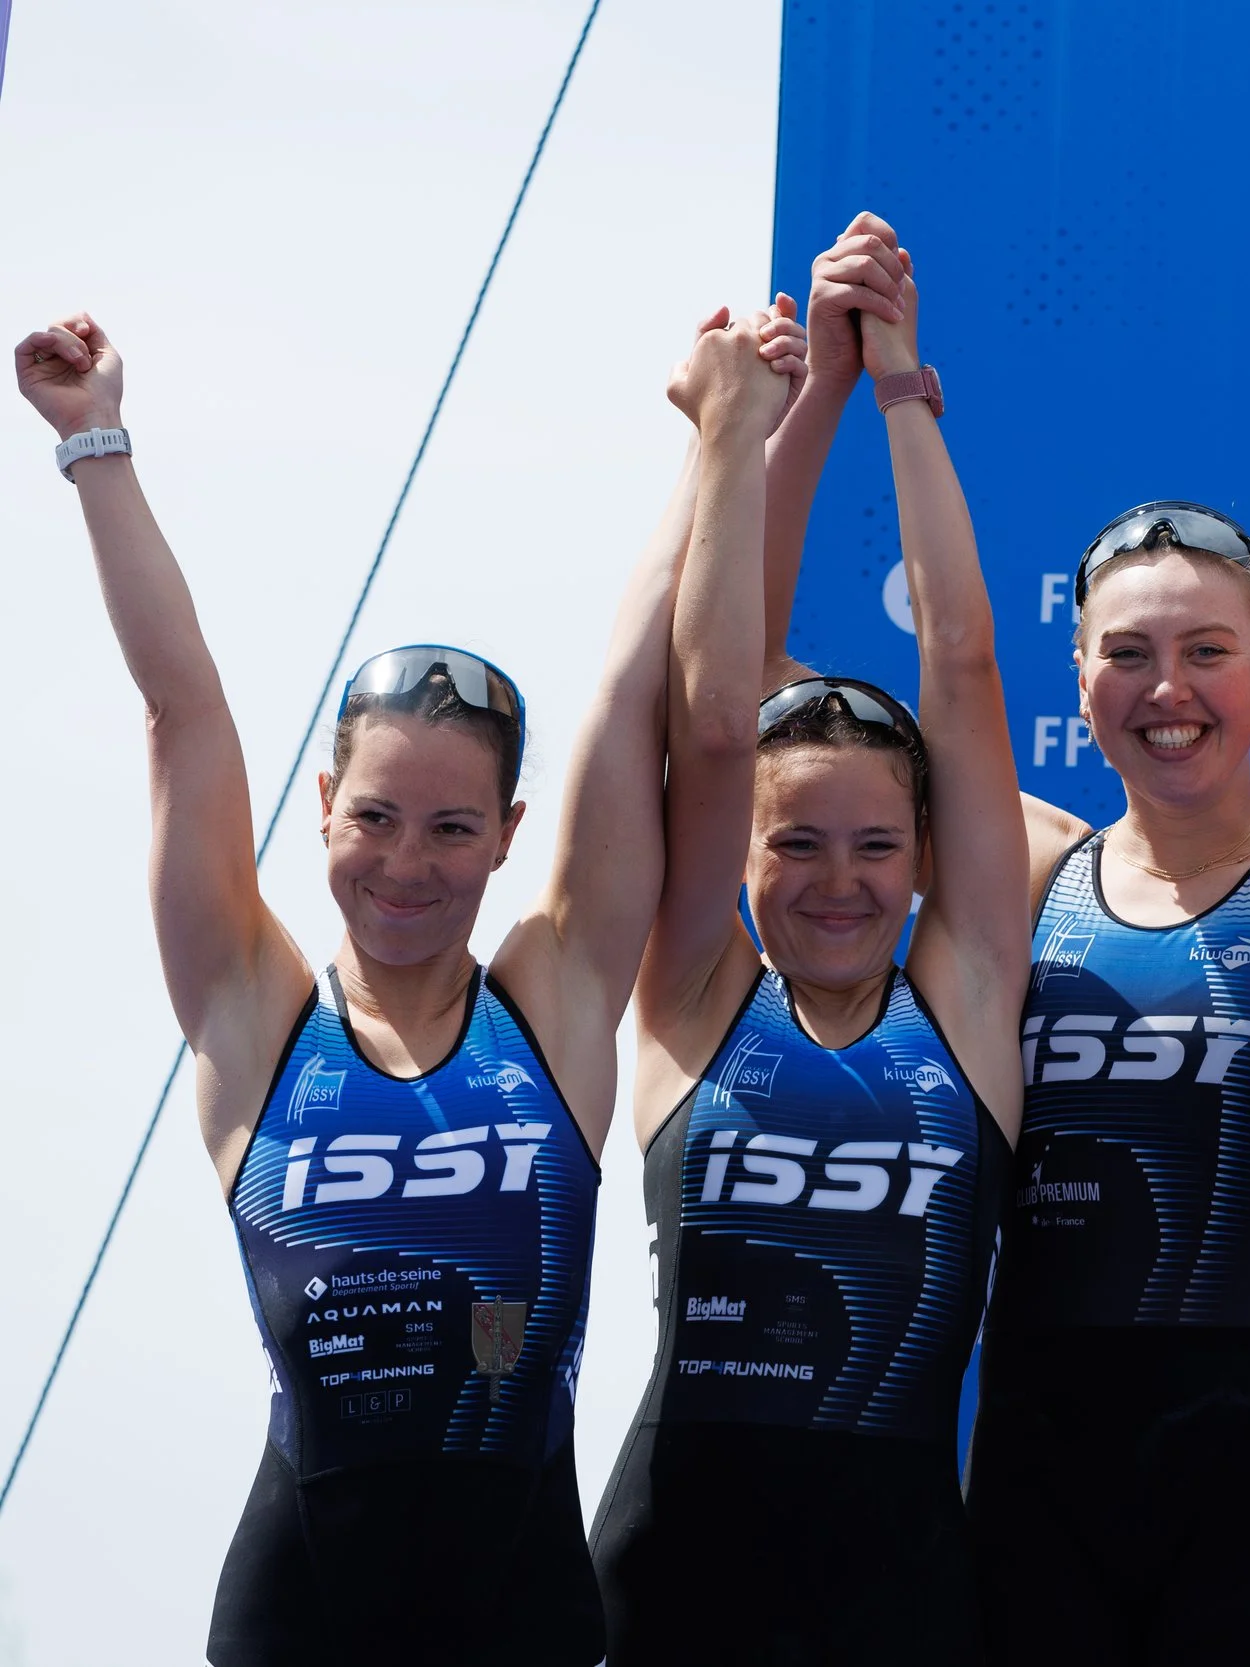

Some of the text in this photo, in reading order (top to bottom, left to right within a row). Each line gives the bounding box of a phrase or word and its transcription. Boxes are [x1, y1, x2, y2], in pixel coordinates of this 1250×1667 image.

[1053, 953, 1082, 968] ISSY
[468, 1071, 525, 1090] kiwami
[738, 1069, 770, 1086] ISSY
[884, 1066, 946, 1085] kiwami
[309, 1088, 337, 1103] ISSY
[281, 1122, 552, 1212] ISSY
[700, 1130, 965, 1218] ISSY
[1040, 1181, 1100, 1203] PREMIUM
[1056, 1216, 1086, 1226] France
[332, 1281, 420, 1297] Département Sportif
[306, 1300, 443, 1325] AQUAMAN
[686, 1296, 747, 1321] BigMat
[405, 1322, 433, 1333] SMS
[308, 1334, 365, 1357] BigMat
[320, 1363, 435, 1388] TOP4RUNNING
[678, 1359, 815, 1381] TOP4RUNNING
